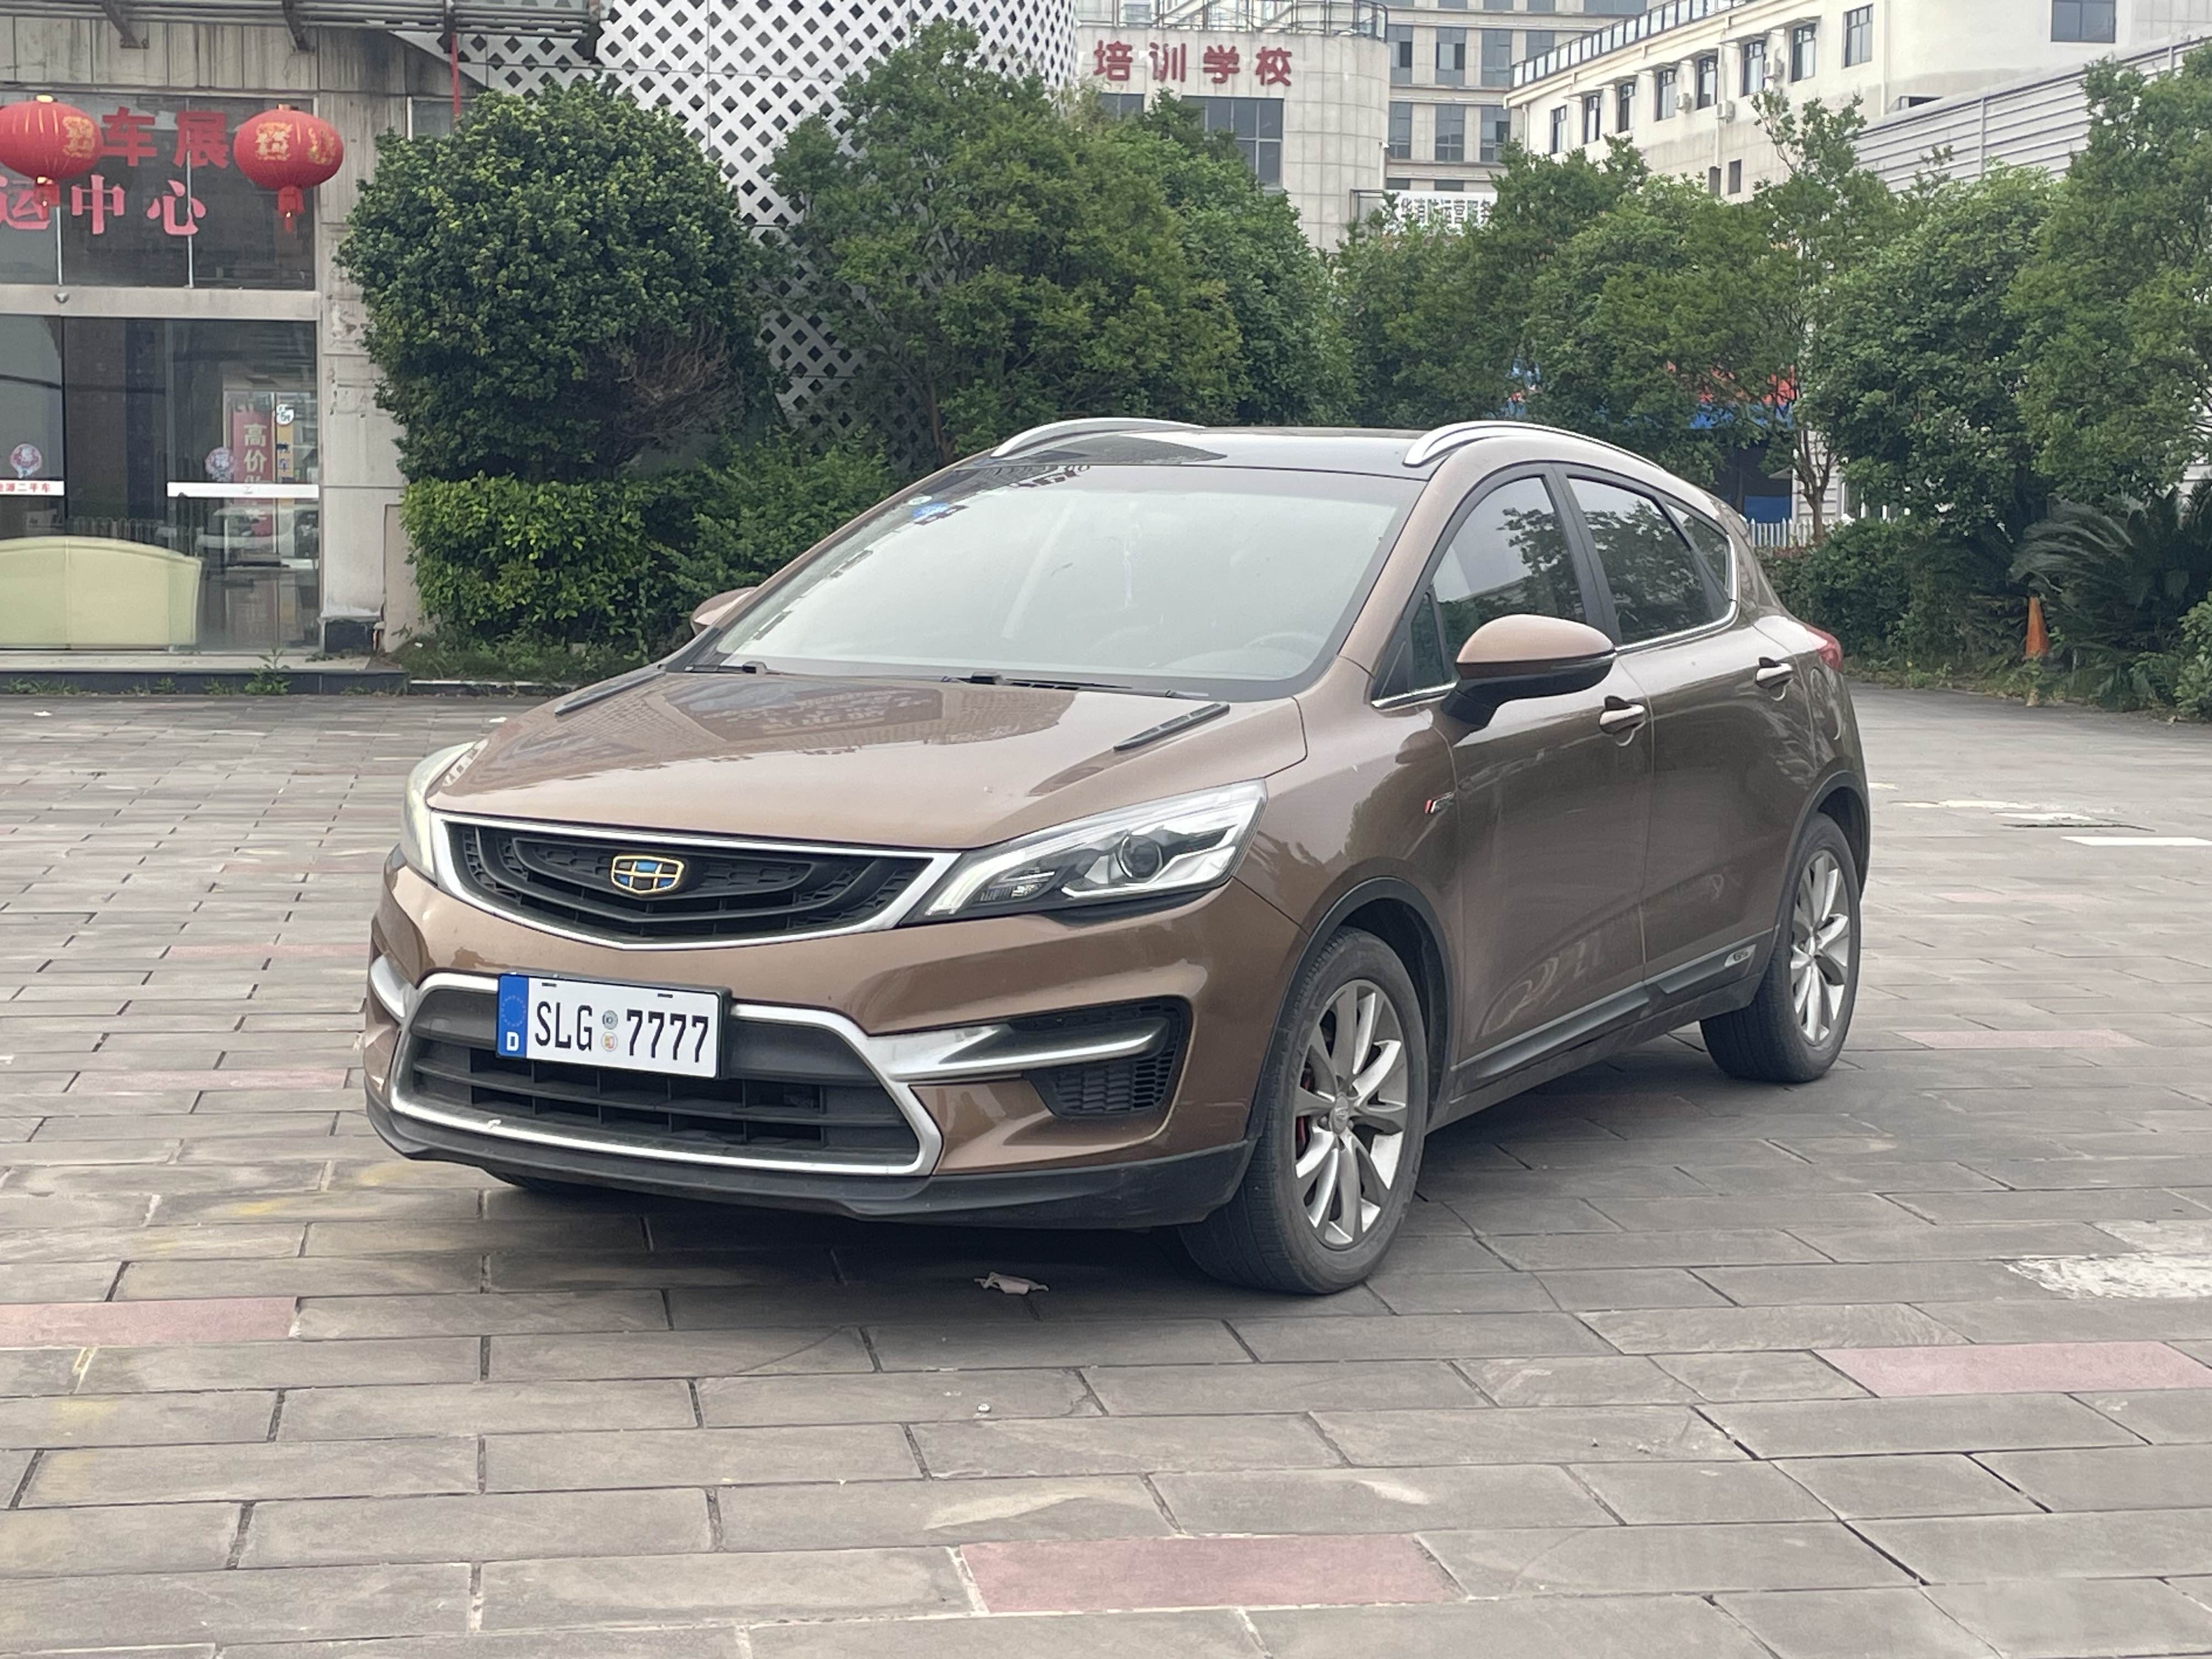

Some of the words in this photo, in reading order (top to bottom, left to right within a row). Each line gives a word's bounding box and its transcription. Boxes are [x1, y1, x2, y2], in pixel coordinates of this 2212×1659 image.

[1093, 40, 1293, 87] 培训学校
[101, 106, 229, 169] 车展
[506, 1031, 519, 1051] D
[534, 1001, 593, 1052] SLG
[626, 1008, 709, 1063] 7777
